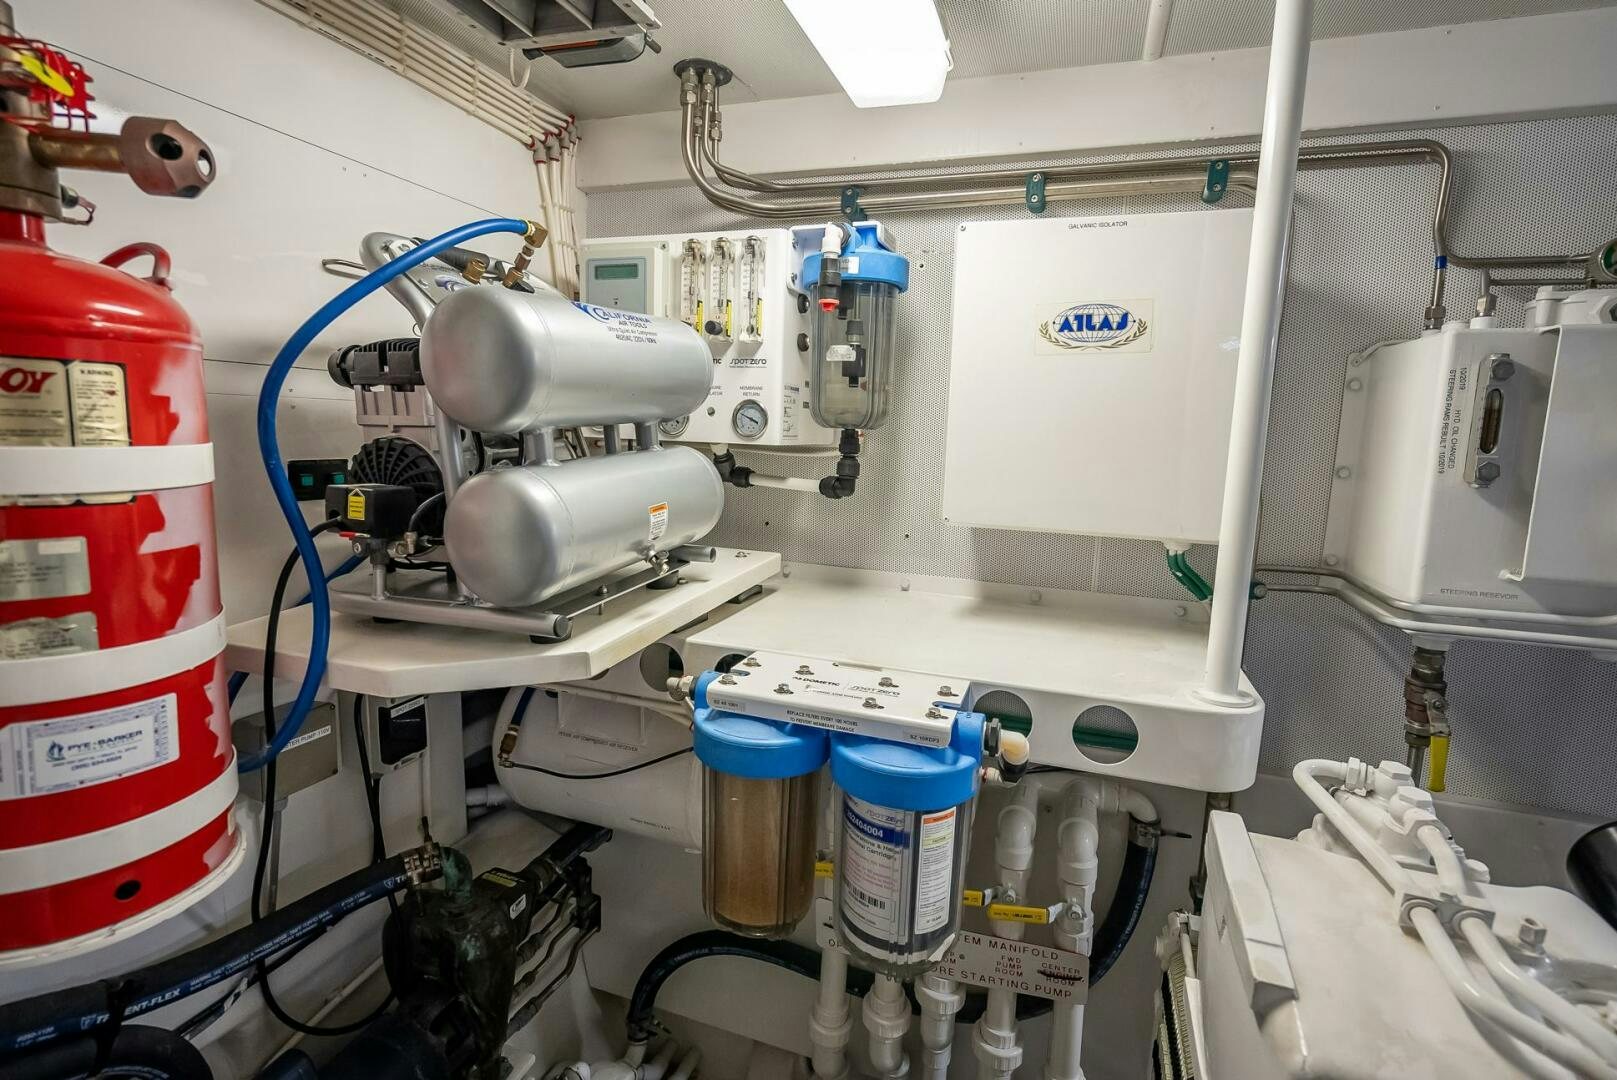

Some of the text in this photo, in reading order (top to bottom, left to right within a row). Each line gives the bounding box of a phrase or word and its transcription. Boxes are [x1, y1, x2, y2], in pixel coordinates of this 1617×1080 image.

[1068, 220, 1128, 230] GALVANIC ISOLATOR
[630, 321, 648, 329] TOOLS
[1058, 311, 1129, 333] ATLAS
[1445, 369, 1456, 402] STEERING
[1442, 402, 1452, 421] RAMS
[1447, 438, 1458, 469] CHANGED
[963, 935, 1060, 961] EM MANIFOLD
[996, 960, 1022, 971] PUMP
[1001, 955, 1022, 964] FWD
[995, 968, 1023, 977] ROOM
[1041, 962, 1081, 975] CENTER
[960, 970, 1030, 992] STARTING
[1034, 984, 1072, 999] PUMP
[1046, 977, 1075, 987] ROOM
